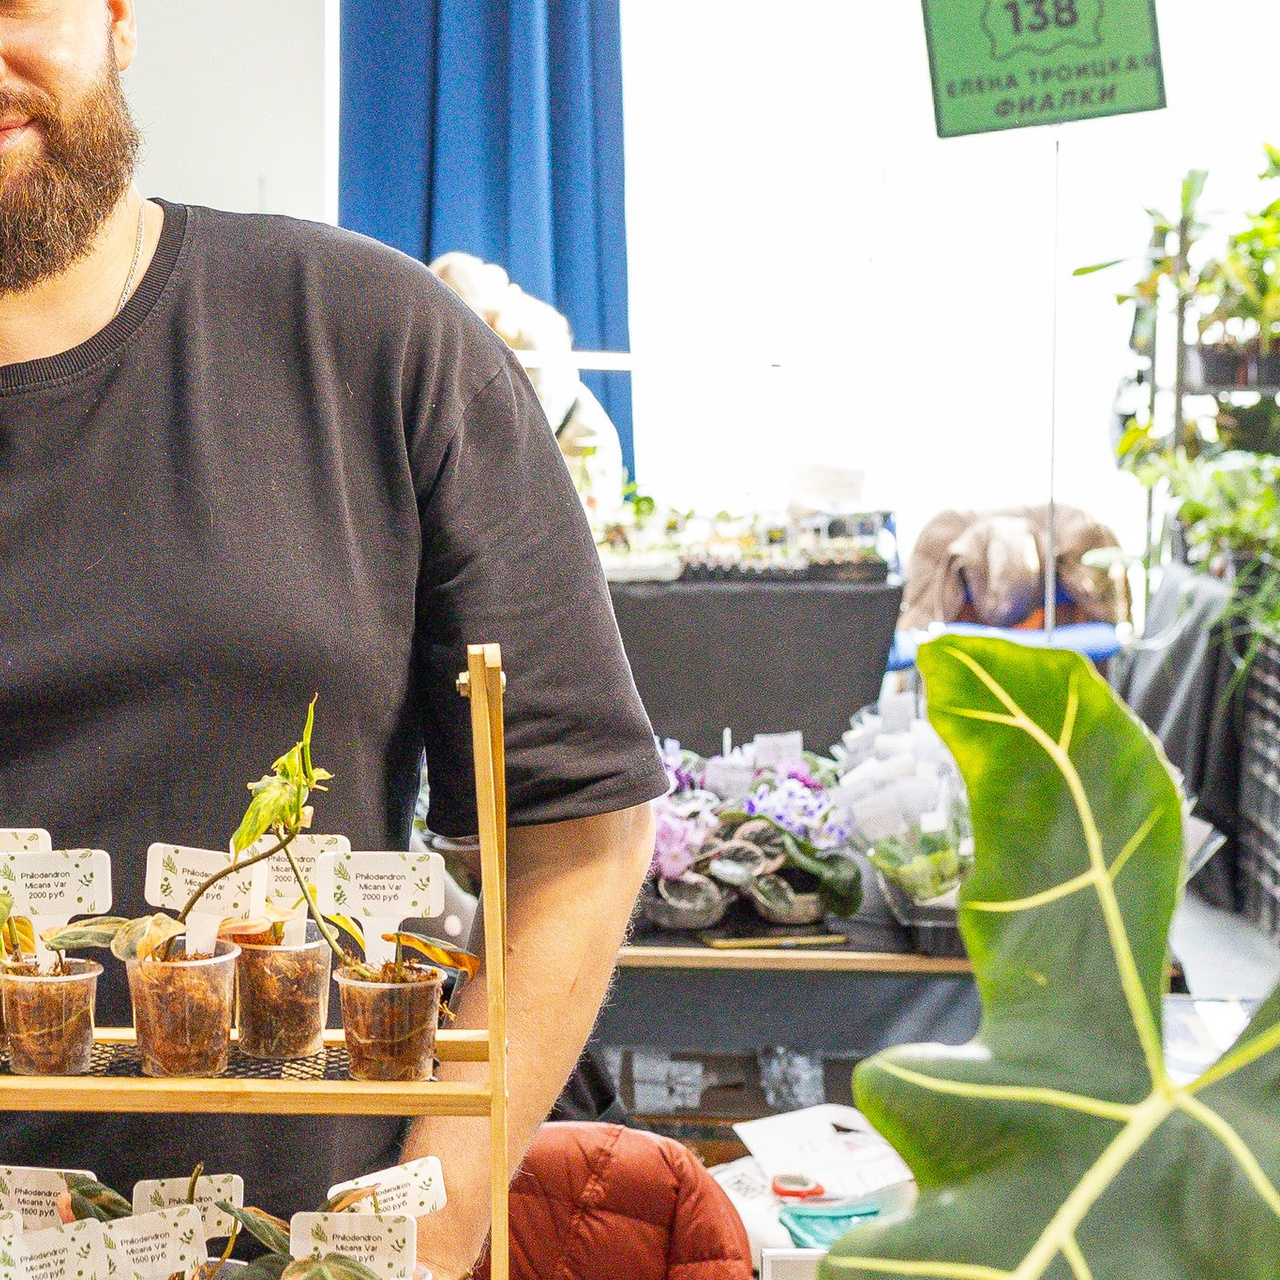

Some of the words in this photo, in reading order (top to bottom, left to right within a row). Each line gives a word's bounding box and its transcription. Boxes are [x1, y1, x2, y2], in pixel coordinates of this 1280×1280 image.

[994, 84, 1117, 118] ФИАЛКИ
[21, 871, 70, 879] Philodendron
[121, 1232, 169, 1246] Philodendron
[21, 1248, 68, 1263] Philodendron
[126, 1246, 151, 1255] Micans
[26, 1262, 51, 1272] Micans
